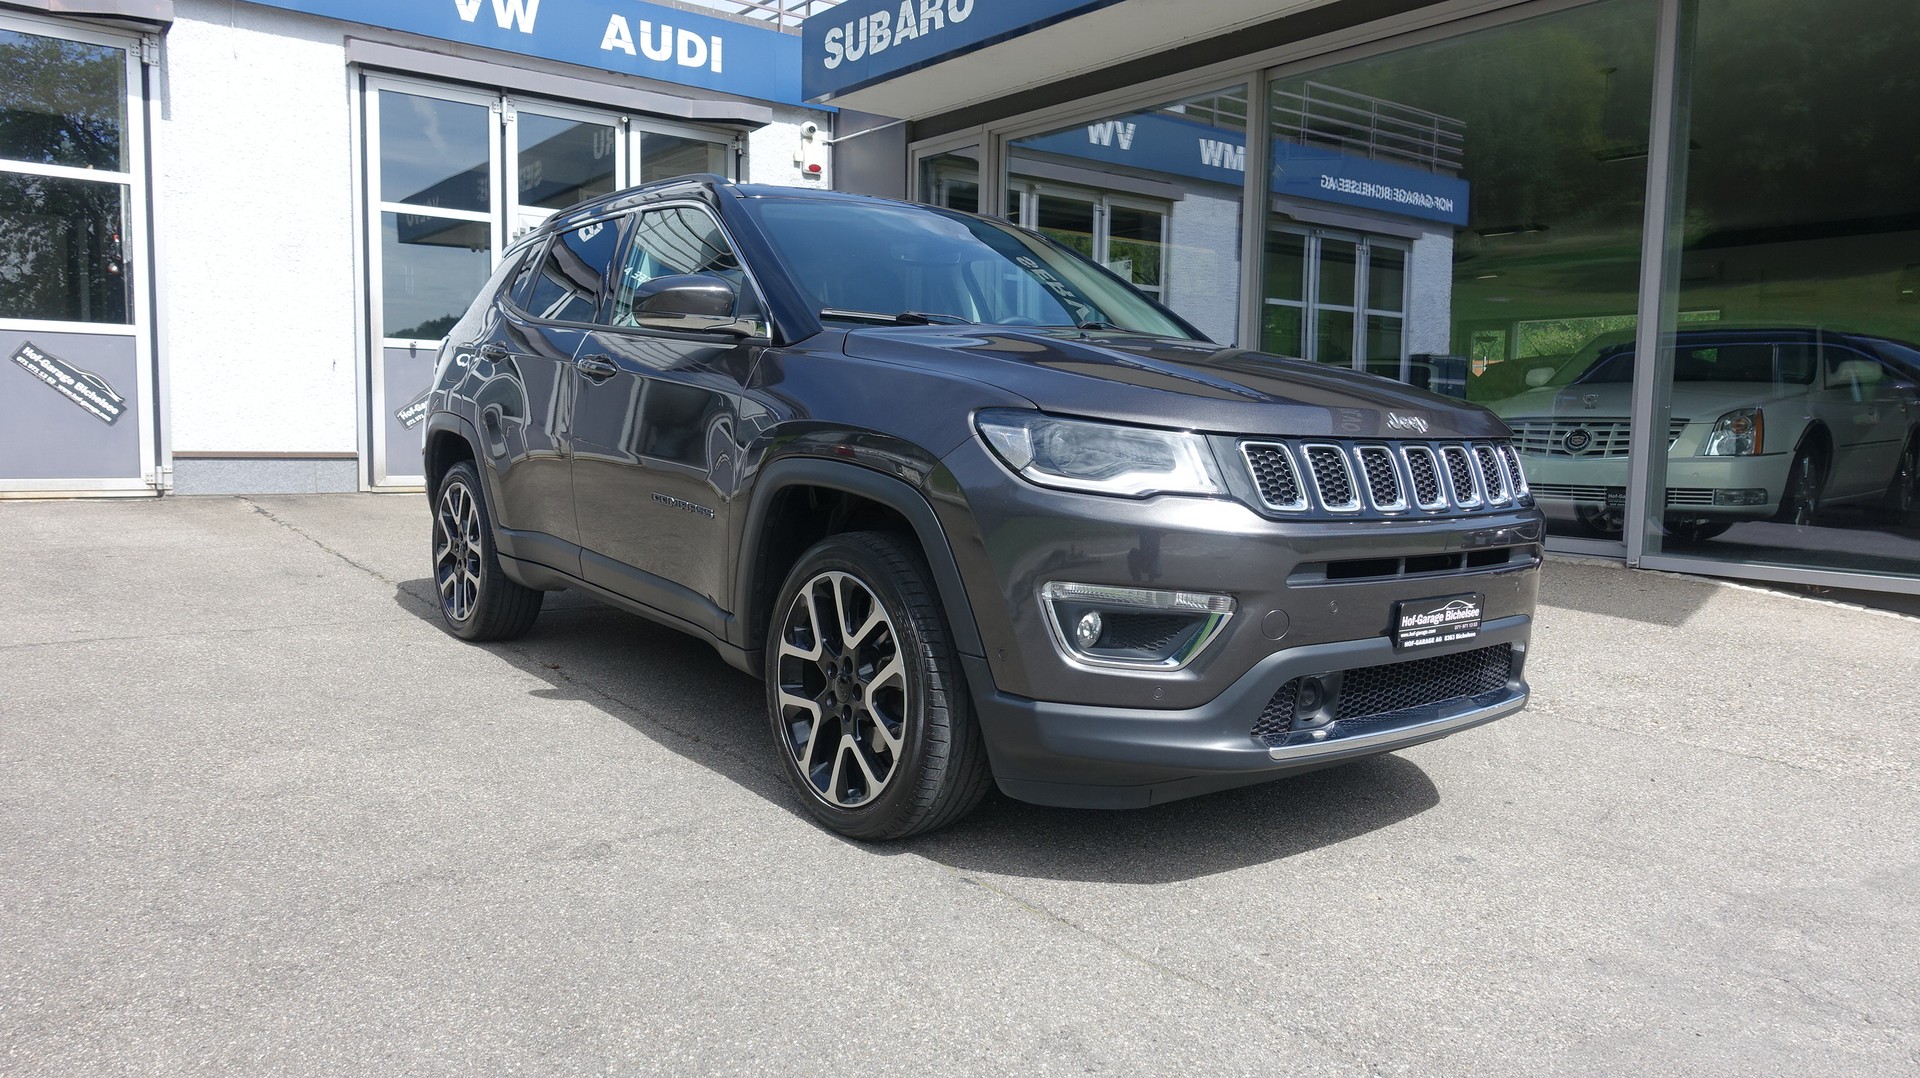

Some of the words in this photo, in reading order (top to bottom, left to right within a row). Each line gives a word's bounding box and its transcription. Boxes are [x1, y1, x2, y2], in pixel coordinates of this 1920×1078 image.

[454, 0, 539, 34] VW
[600, 13, 722, 74] AUDI
[22, 346, 75, 385] Hof-Garage
[74, 381, 119, 415] Bichelsee
[400, 401, 428, 420] Hof-Ga
[1387, 412, 1429, 434] Jeep
[651, 491, 715, 520] COMPASS
[1401, 612, 1445, 627] Hof-Garage
[1445, 608, 1480, 621] Bichelsee
[1404, 638, 1435, 648] HOF-GARAGE
